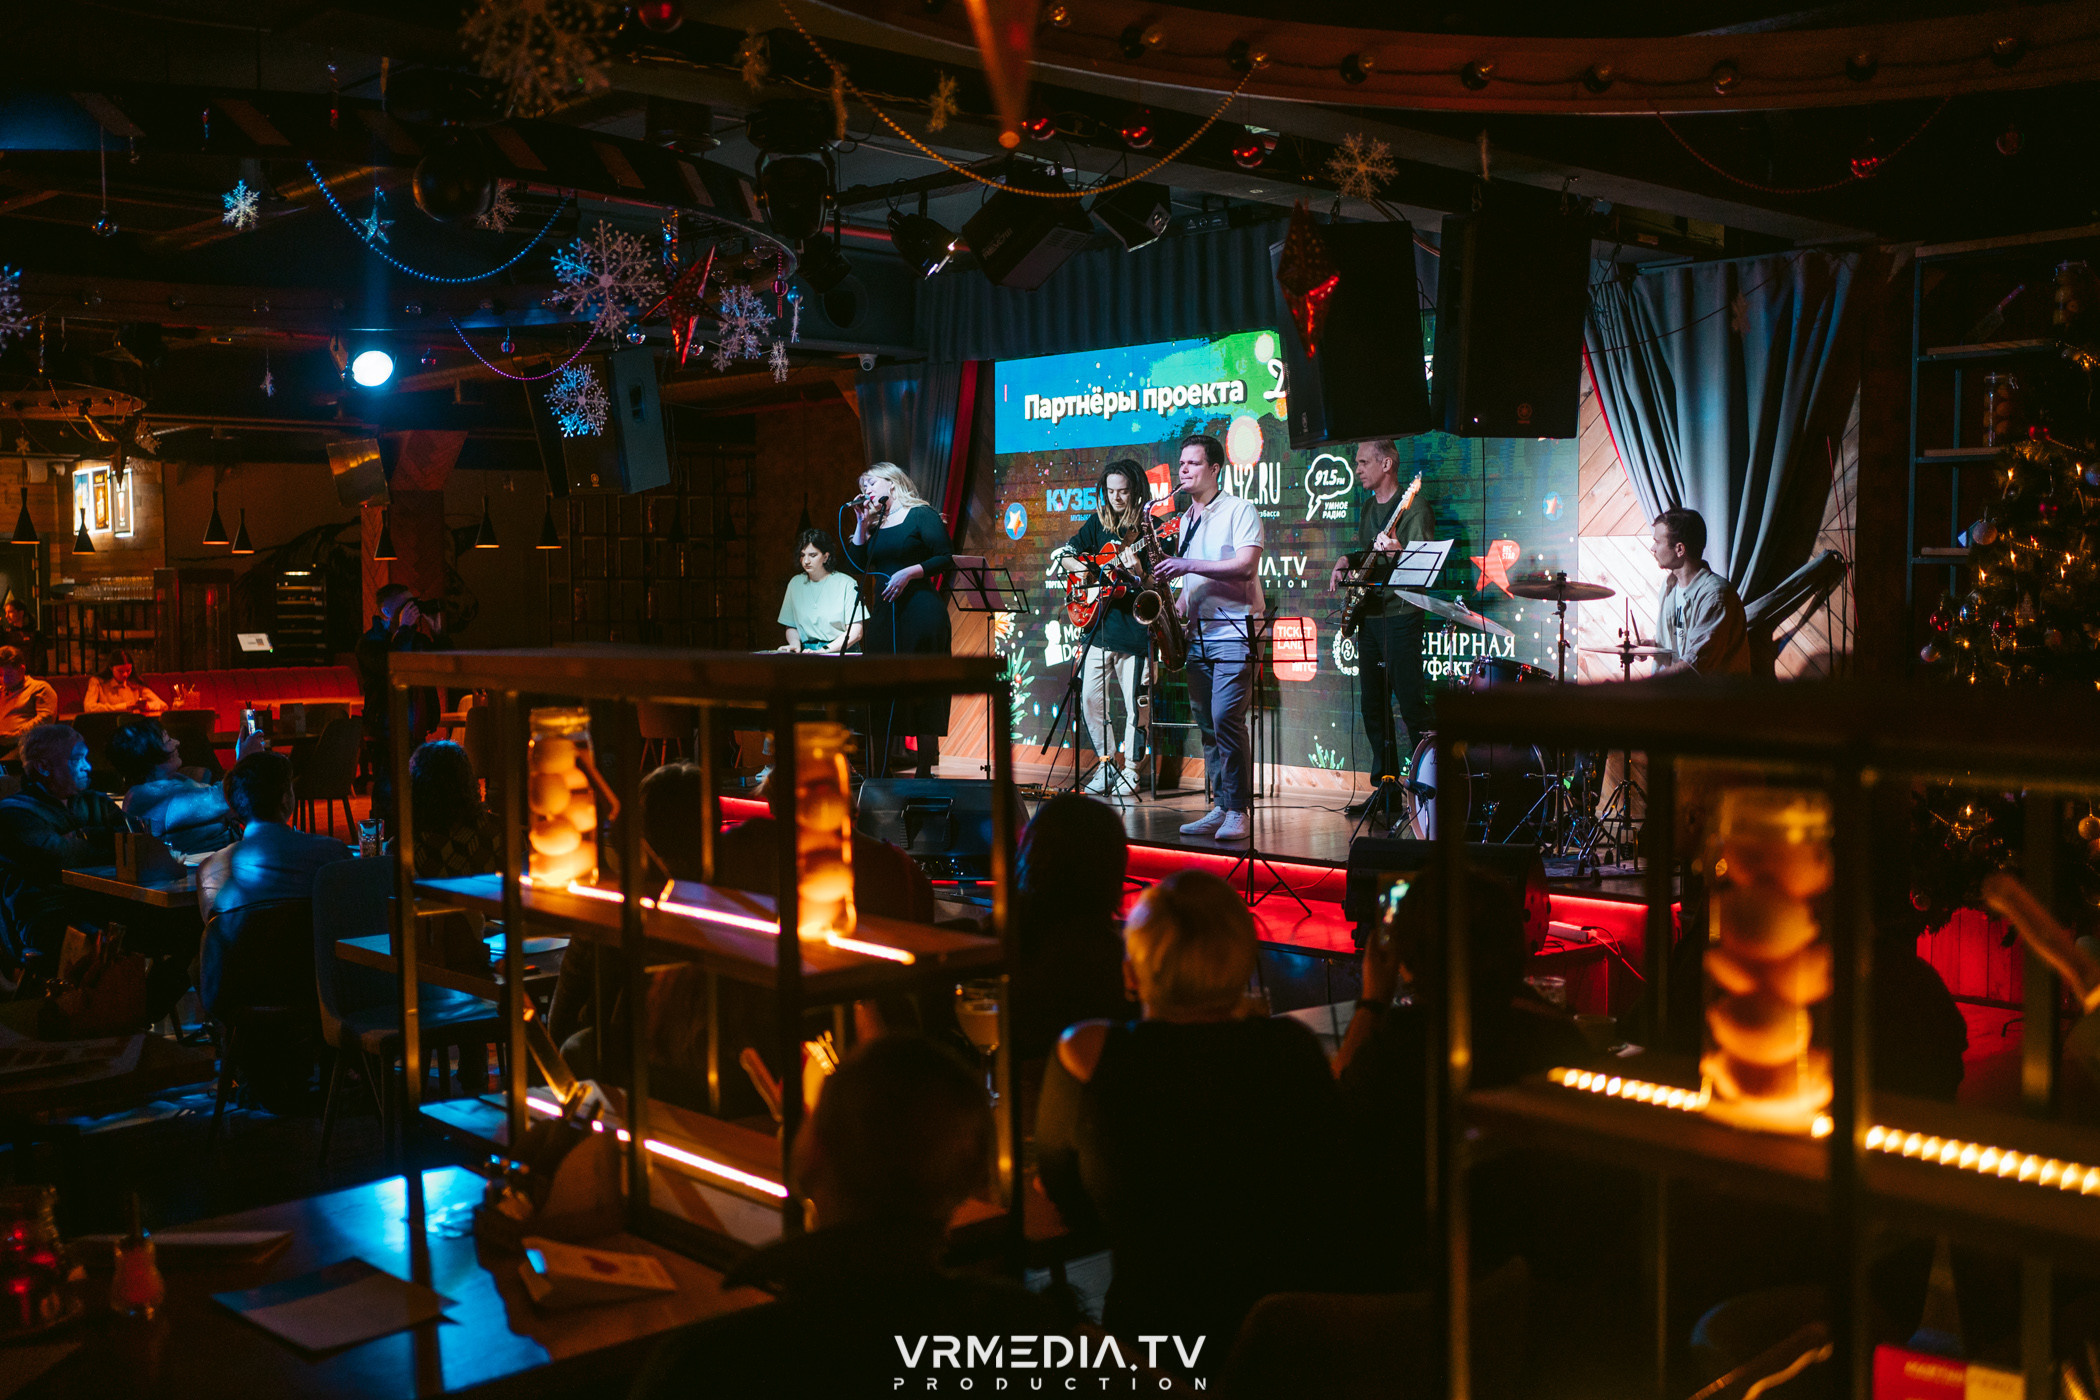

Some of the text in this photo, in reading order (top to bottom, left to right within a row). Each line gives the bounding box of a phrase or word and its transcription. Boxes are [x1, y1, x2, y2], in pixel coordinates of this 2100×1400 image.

[1024, 379, 1246, 423] Партнёры проекта
[1218, 461, 1281, 505] A42.RU
[1314, 469, 1338, 486] 91.5
[1324, 501, 1349, 511] УМНОЕ
[1322, 510, 1347, 520] РАДИО
[1265, 580, 1308, 589] TION
[1277, 625, 1312, 638] TICKET
[1277, 638, 1304, 650] LAND
